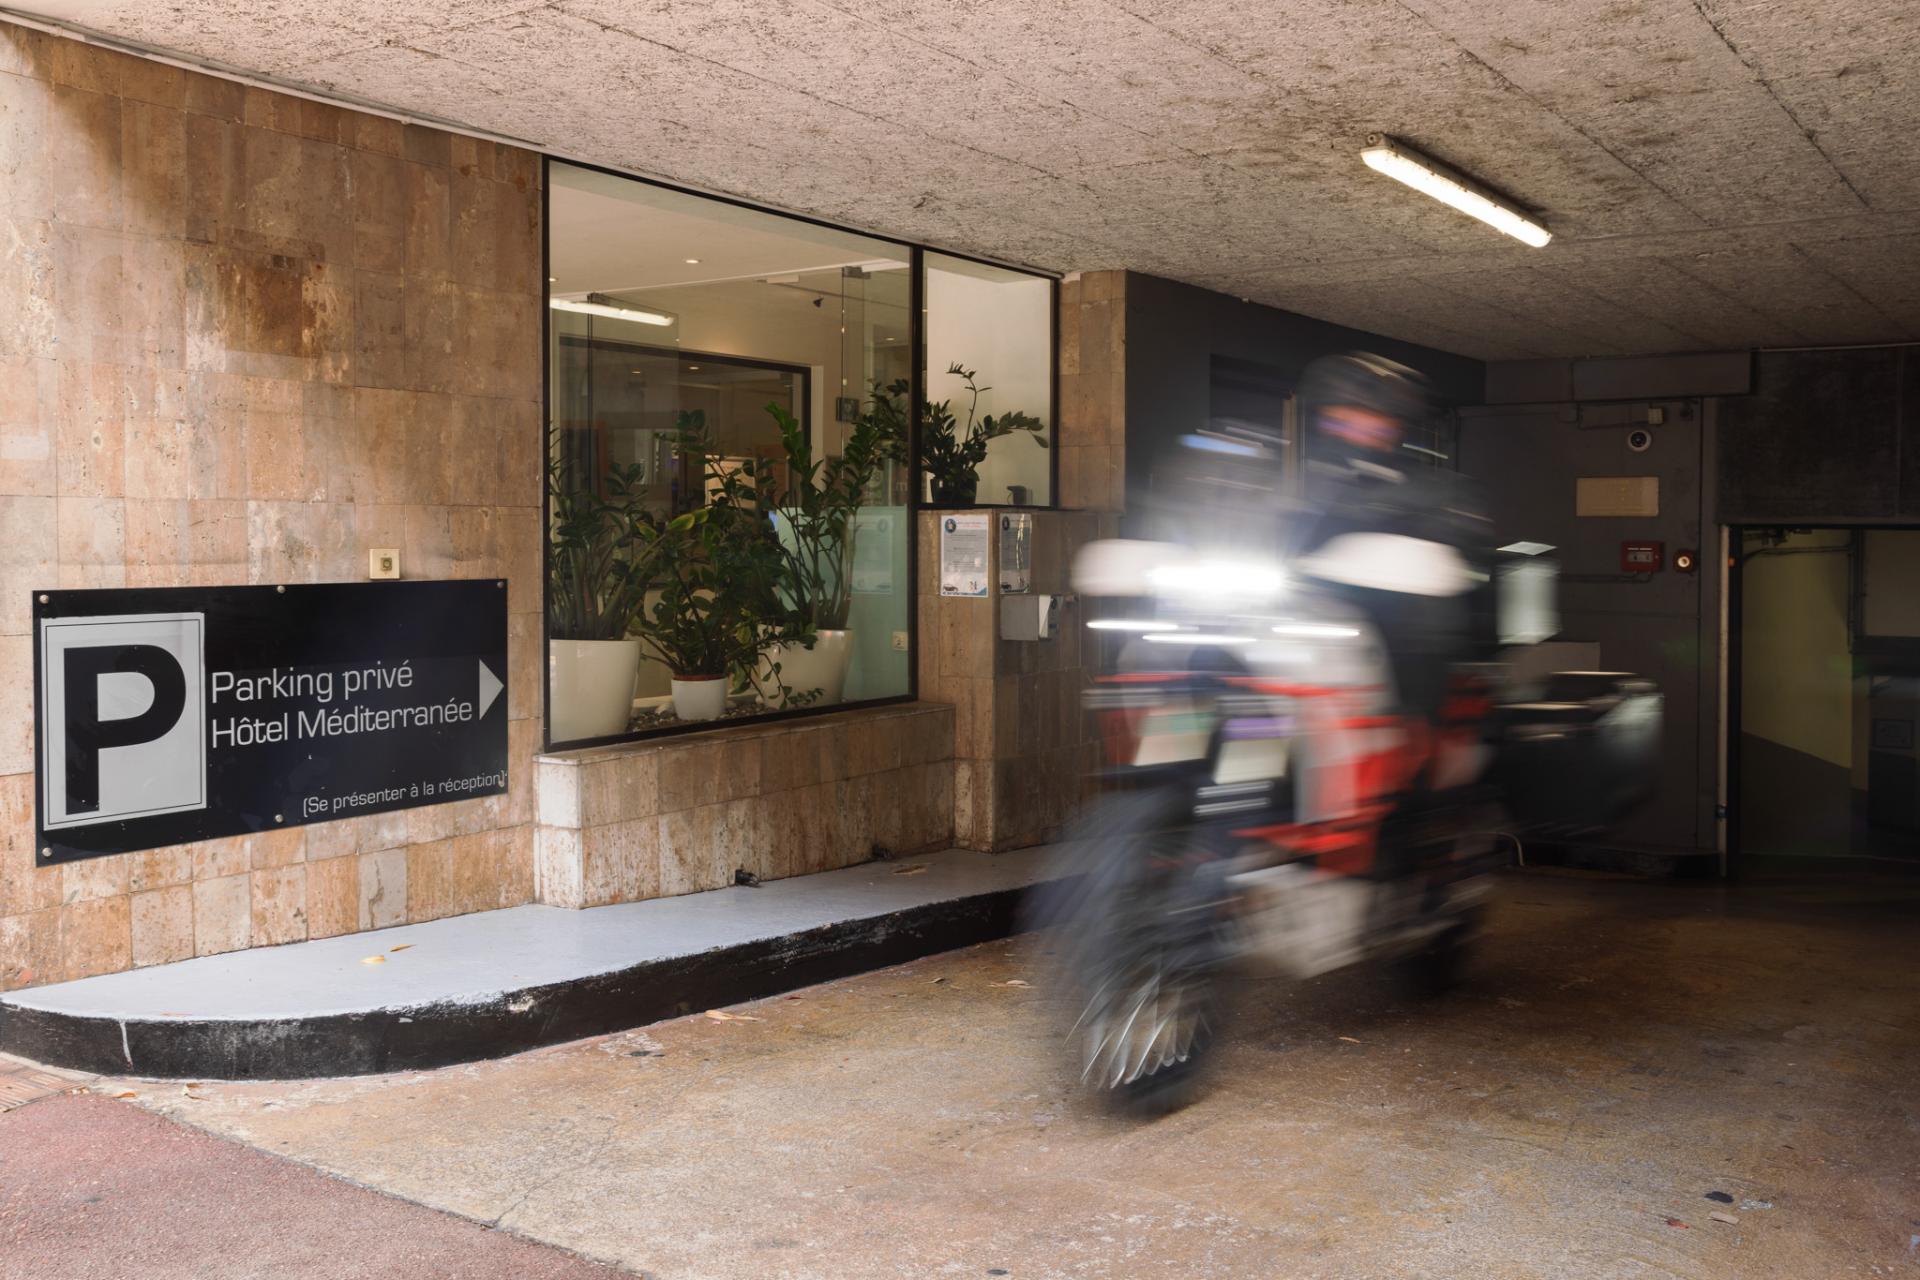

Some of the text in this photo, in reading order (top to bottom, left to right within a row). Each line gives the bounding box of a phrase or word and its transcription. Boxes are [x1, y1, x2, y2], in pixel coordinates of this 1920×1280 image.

[212, 659, 413, 702] Parking privé
[64, 644, 186, 815] P
[212, 698, 473, 748] Hôtel Méditerranée
[303, 796, 328, 817] (Se
[333, 787, 407, 812] présenter
[410, 783, 419, 798] à
[423, 781, 434, 796] la
